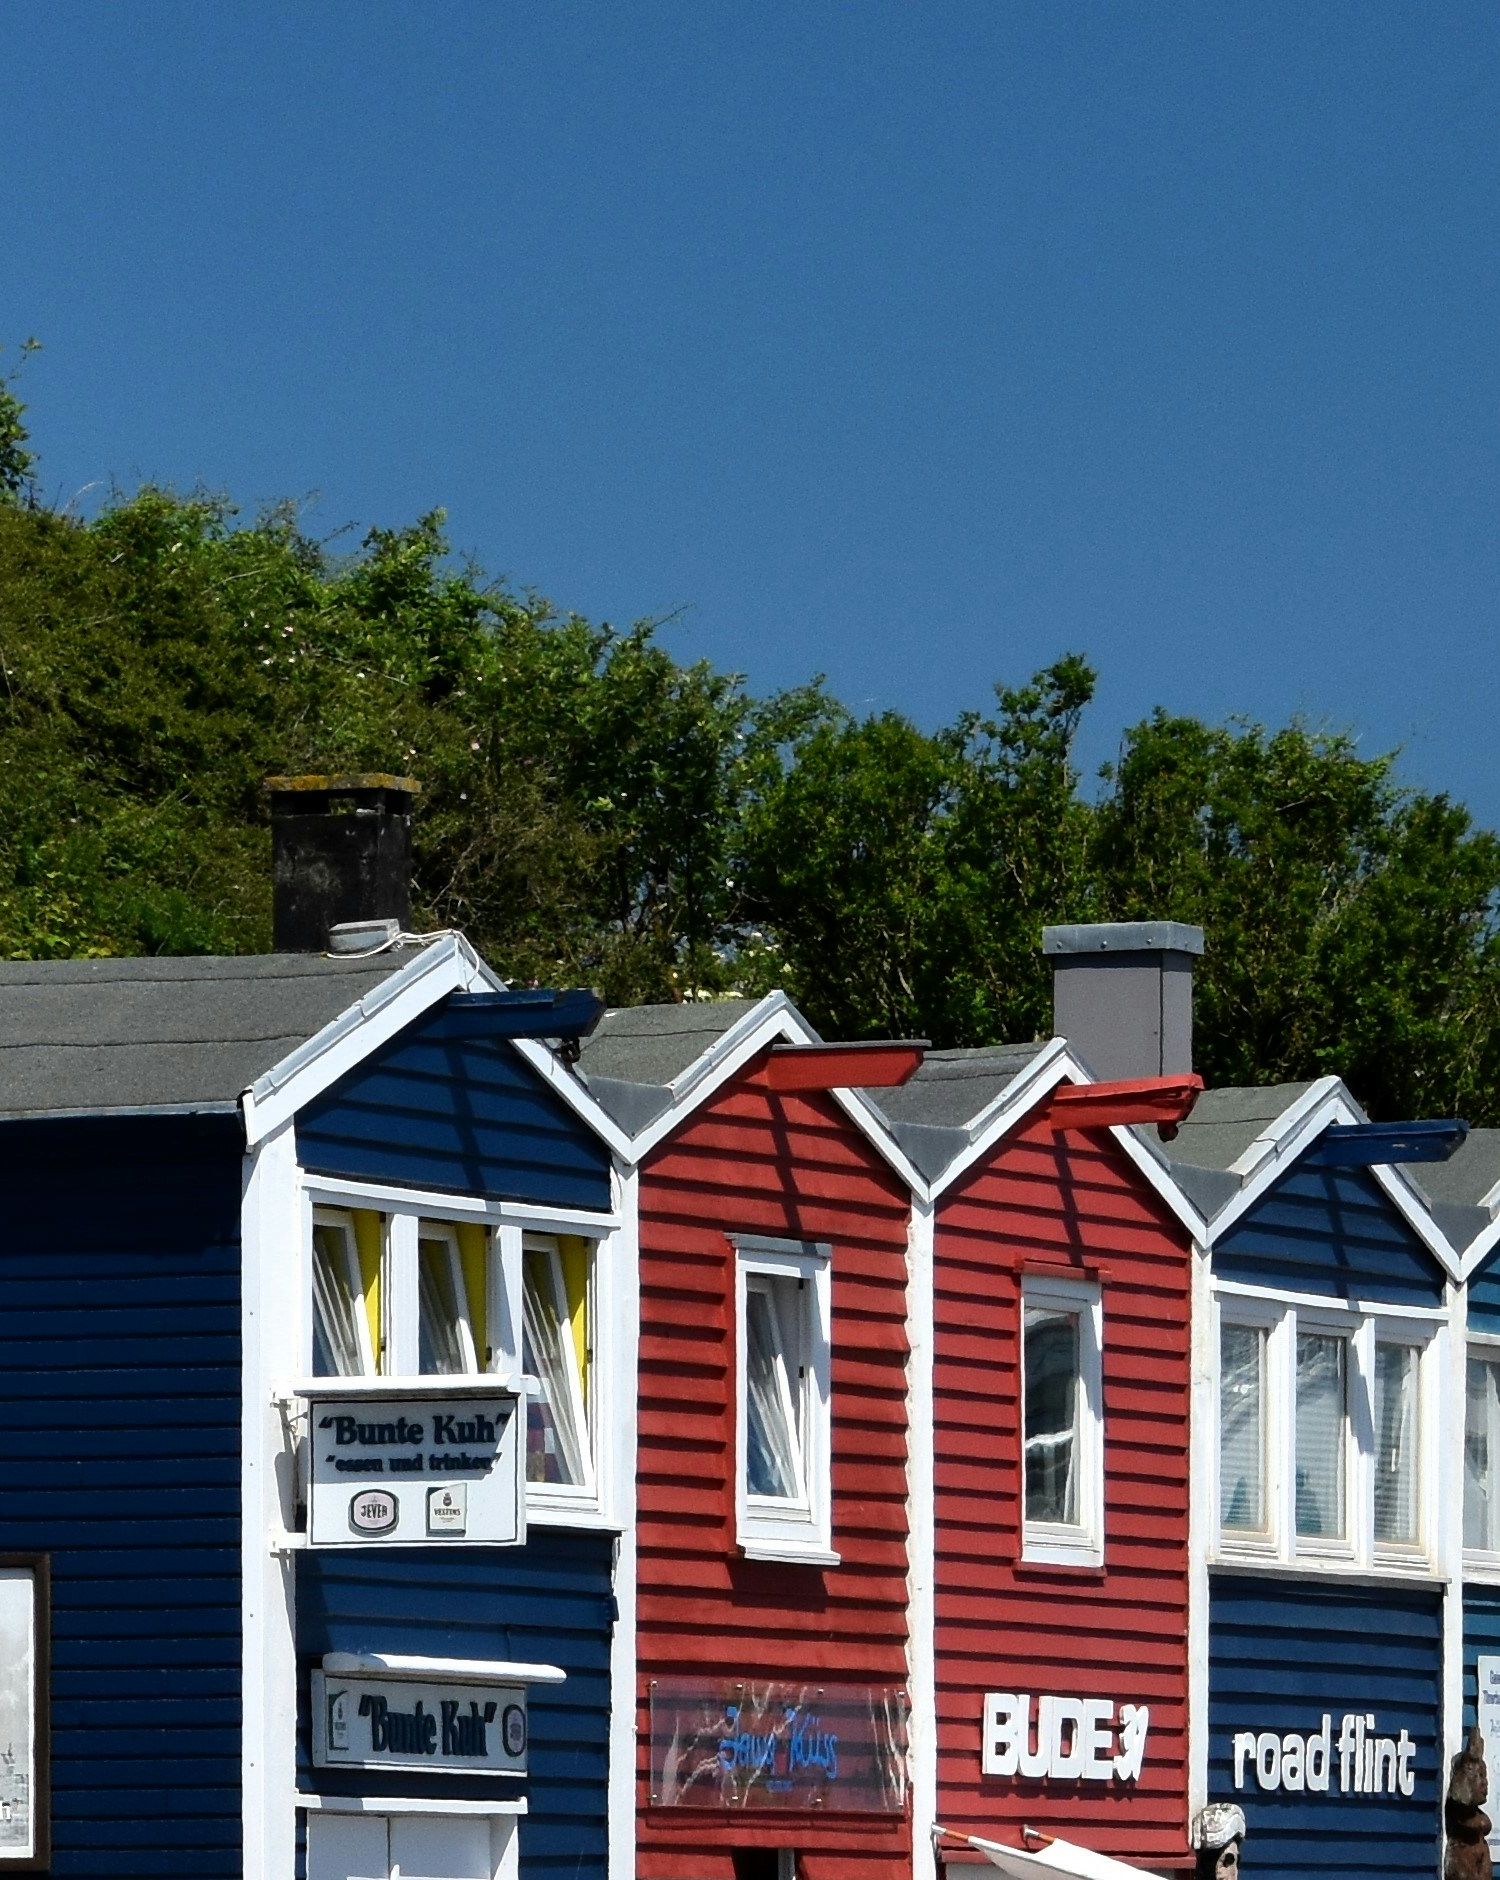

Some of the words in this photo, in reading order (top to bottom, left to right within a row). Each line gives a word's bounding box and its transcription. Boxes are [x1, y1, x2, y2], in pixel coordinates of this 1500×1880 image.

[389, 1453, 424, 1472] und
[360, 1504, 388, 1519] JEVER
[434, 1507, 461, 1517] VELTINS
[982, 1693, 1114, 1780] BUDE
[1232, 1713, 1332, 1792] road
[1335, 1713, 1416, 1796] flint
